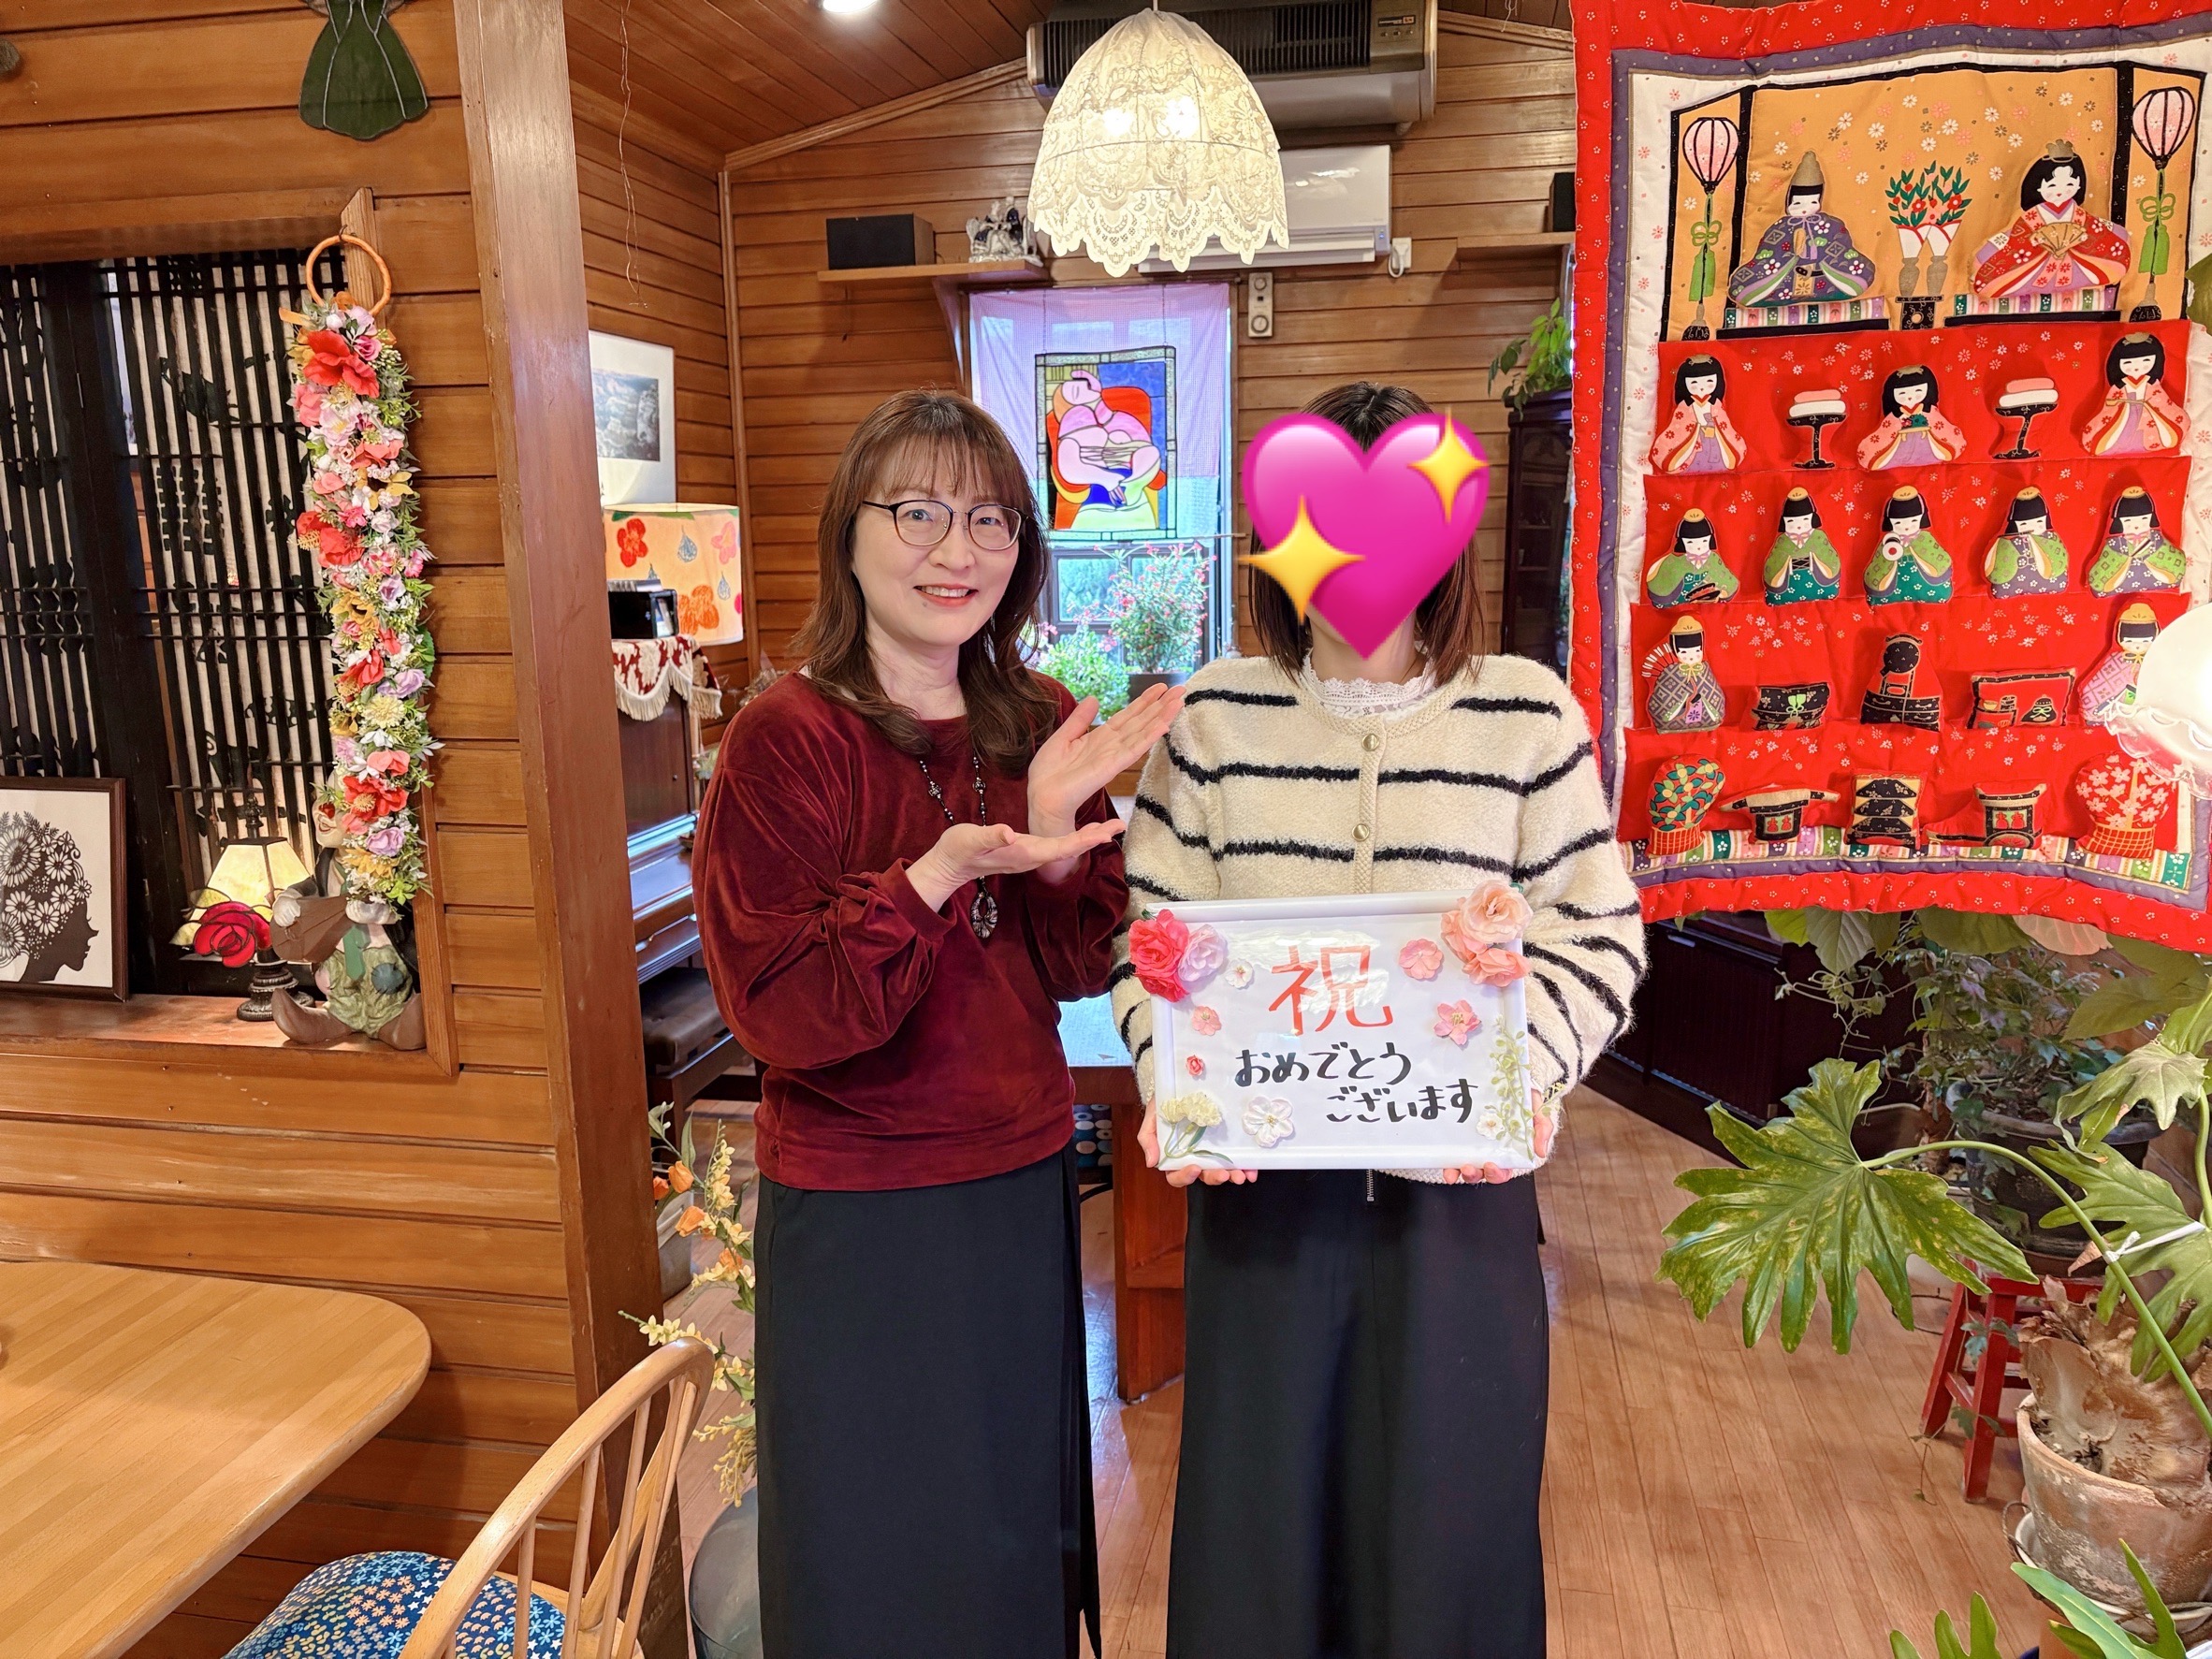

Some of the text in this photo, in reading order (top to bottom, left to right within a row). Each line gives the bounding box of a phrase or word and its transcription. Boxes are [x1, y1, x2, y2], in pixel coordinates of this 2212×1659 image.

[1269, 944, 1393, 1036] 祝
[1234, 1041, 1411, 1086] おめでとう
[1326, 1079, 1478, 1124] ございます
